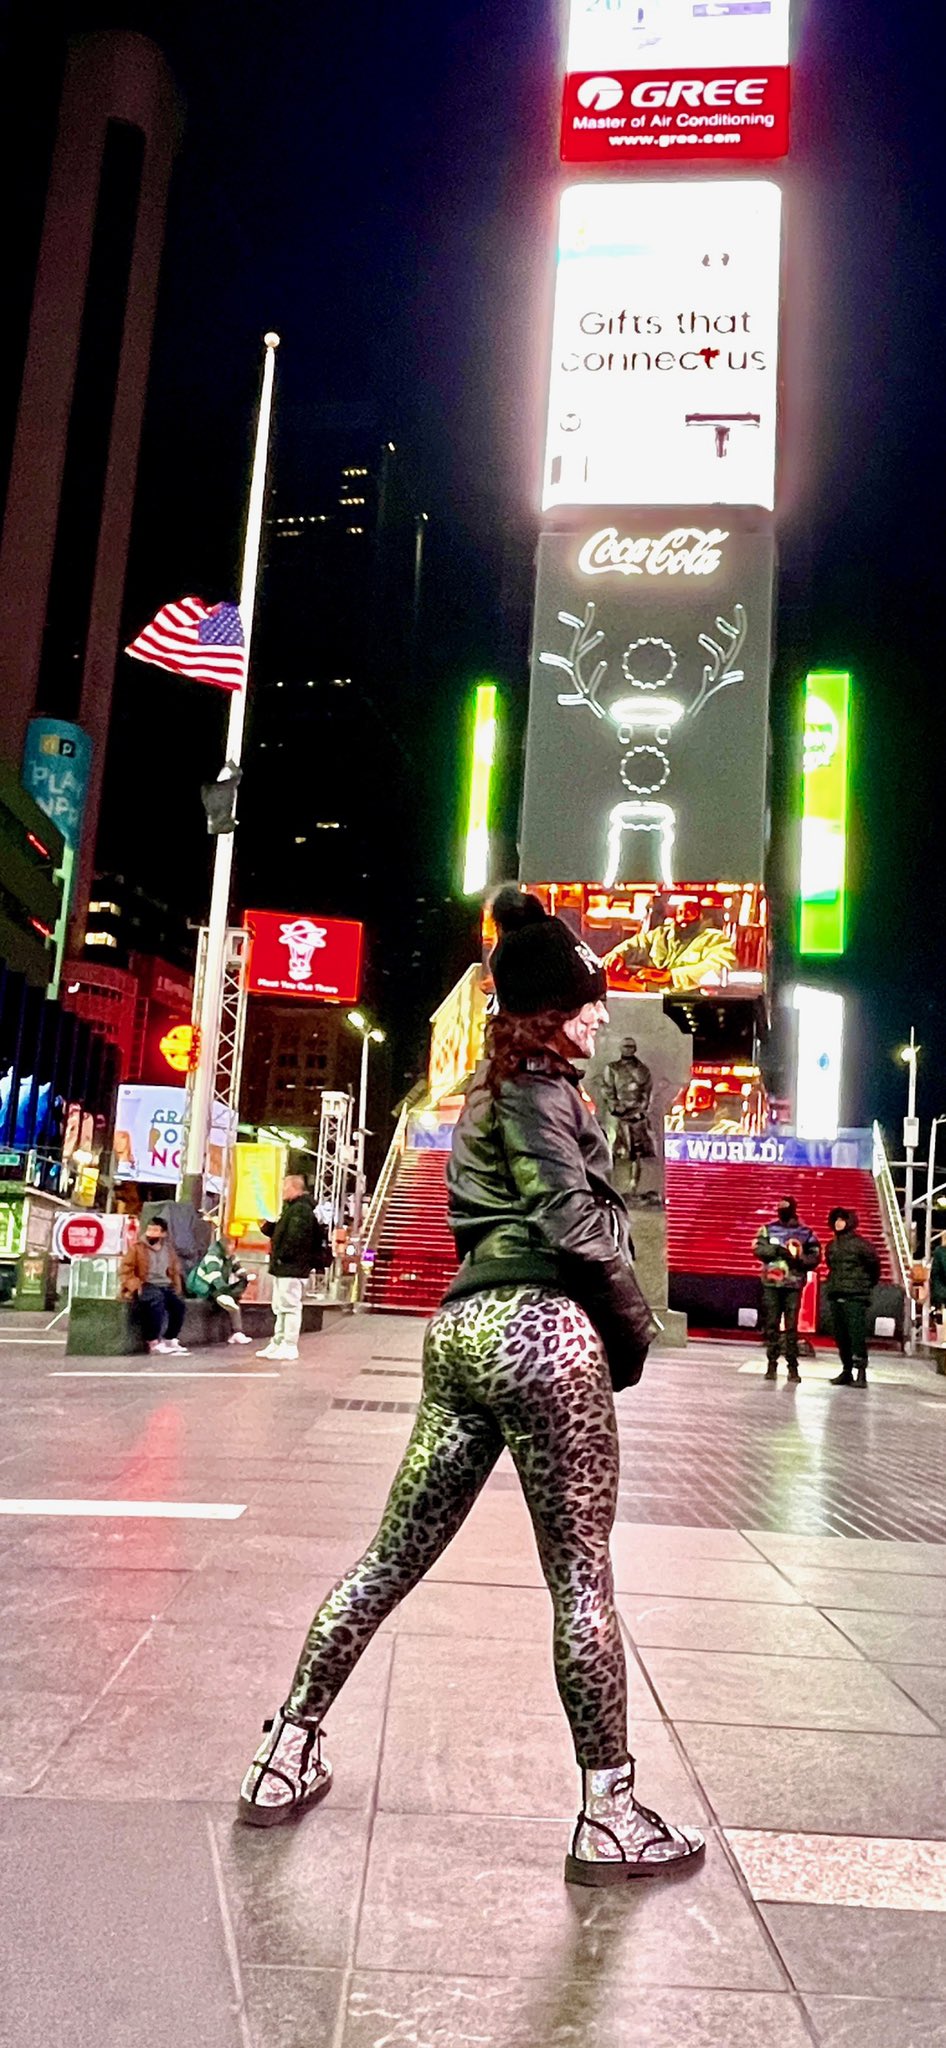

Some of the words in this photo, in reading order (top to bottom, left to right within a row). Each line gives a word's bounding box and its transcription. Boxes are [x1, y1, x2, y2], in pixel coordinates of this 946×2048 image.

[631, 78, 769, 108] GREE
[573, 115, 627, 130] Master
[631, 114, 646, 127] of
[650, 114, 672, 127] Air
[676, 112, 775, 128] Conditioning
[609, 132, 741, 147] www.gree.com
[580, 309, 662, 335] Gifts
[677, 310, 751, 334] that
[561, 347, 720, 372] connect
[728, 350, 767, 371] us
[687, 1139, 785, 1162] WORLD!
